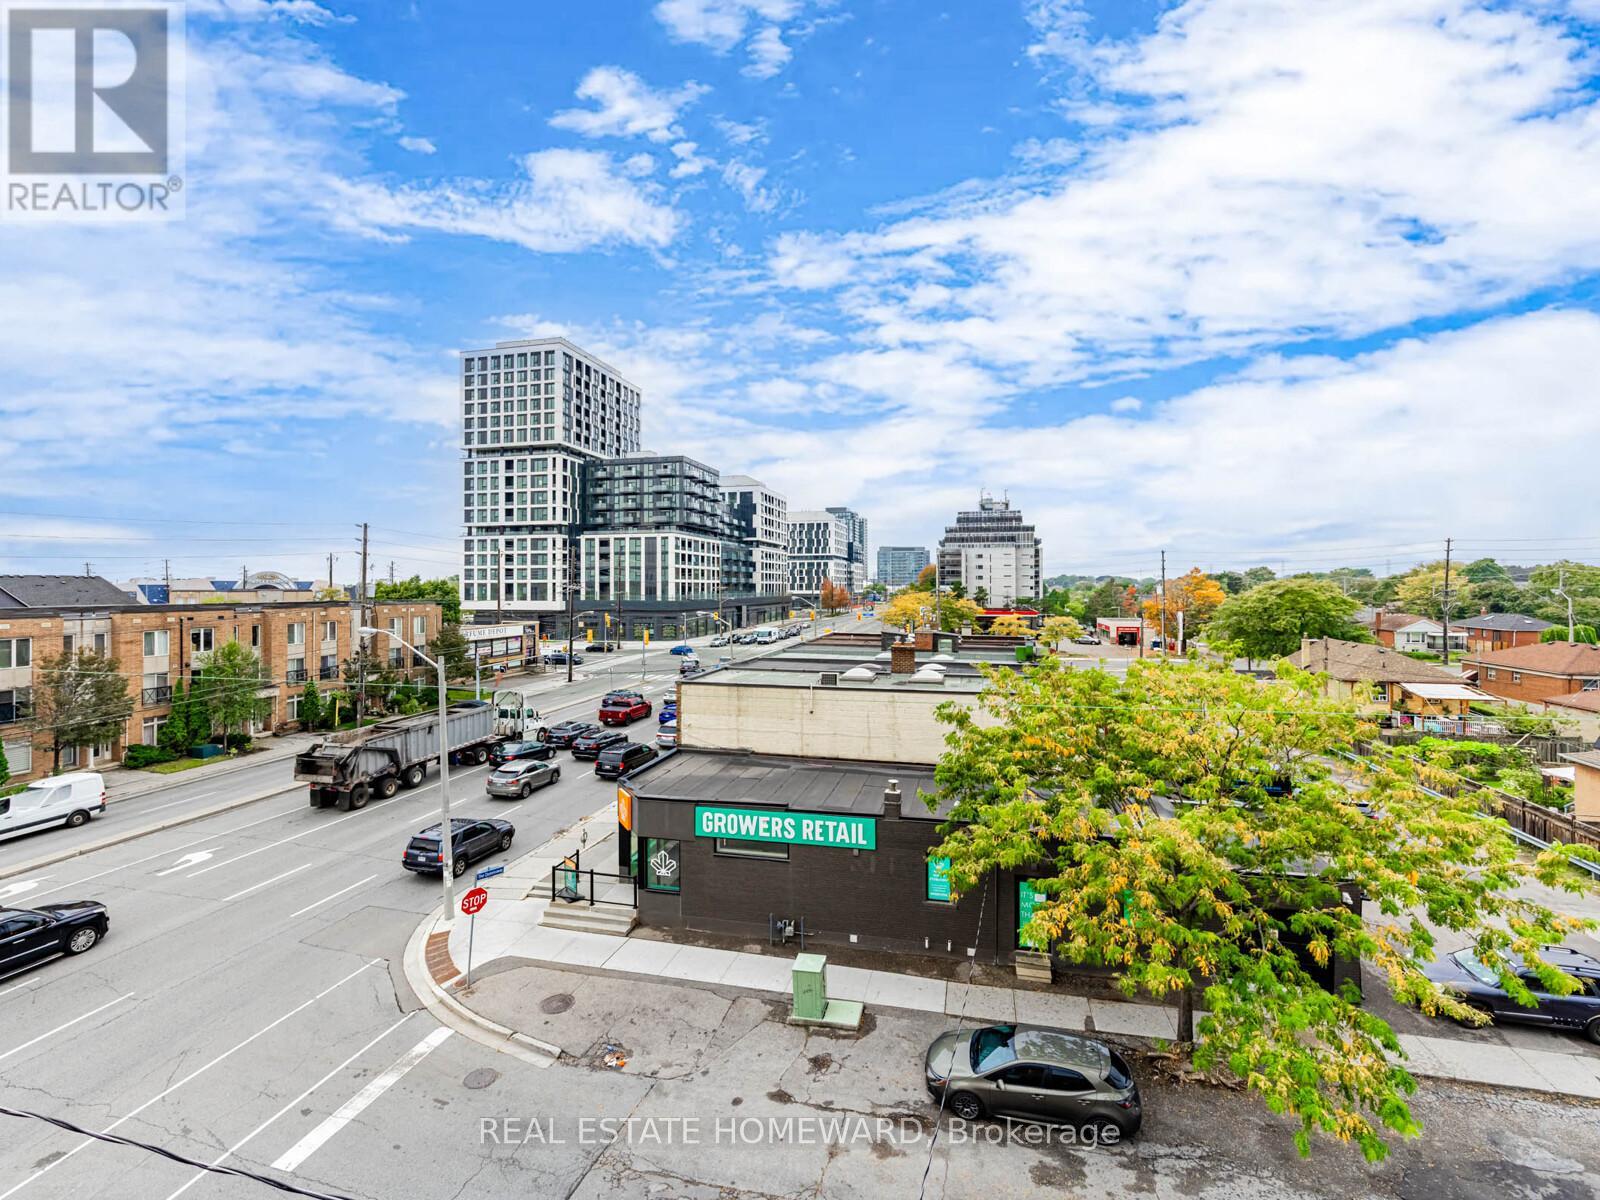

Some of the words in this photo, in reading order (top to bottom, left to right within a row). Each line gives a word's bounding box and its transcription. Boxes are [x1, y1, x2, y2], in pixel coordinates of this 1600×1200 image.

[702, 812, 796, 839] GROWERS
[802, 819, 867, 845] RETAIL
[462, 893, 487, 909] STOP
